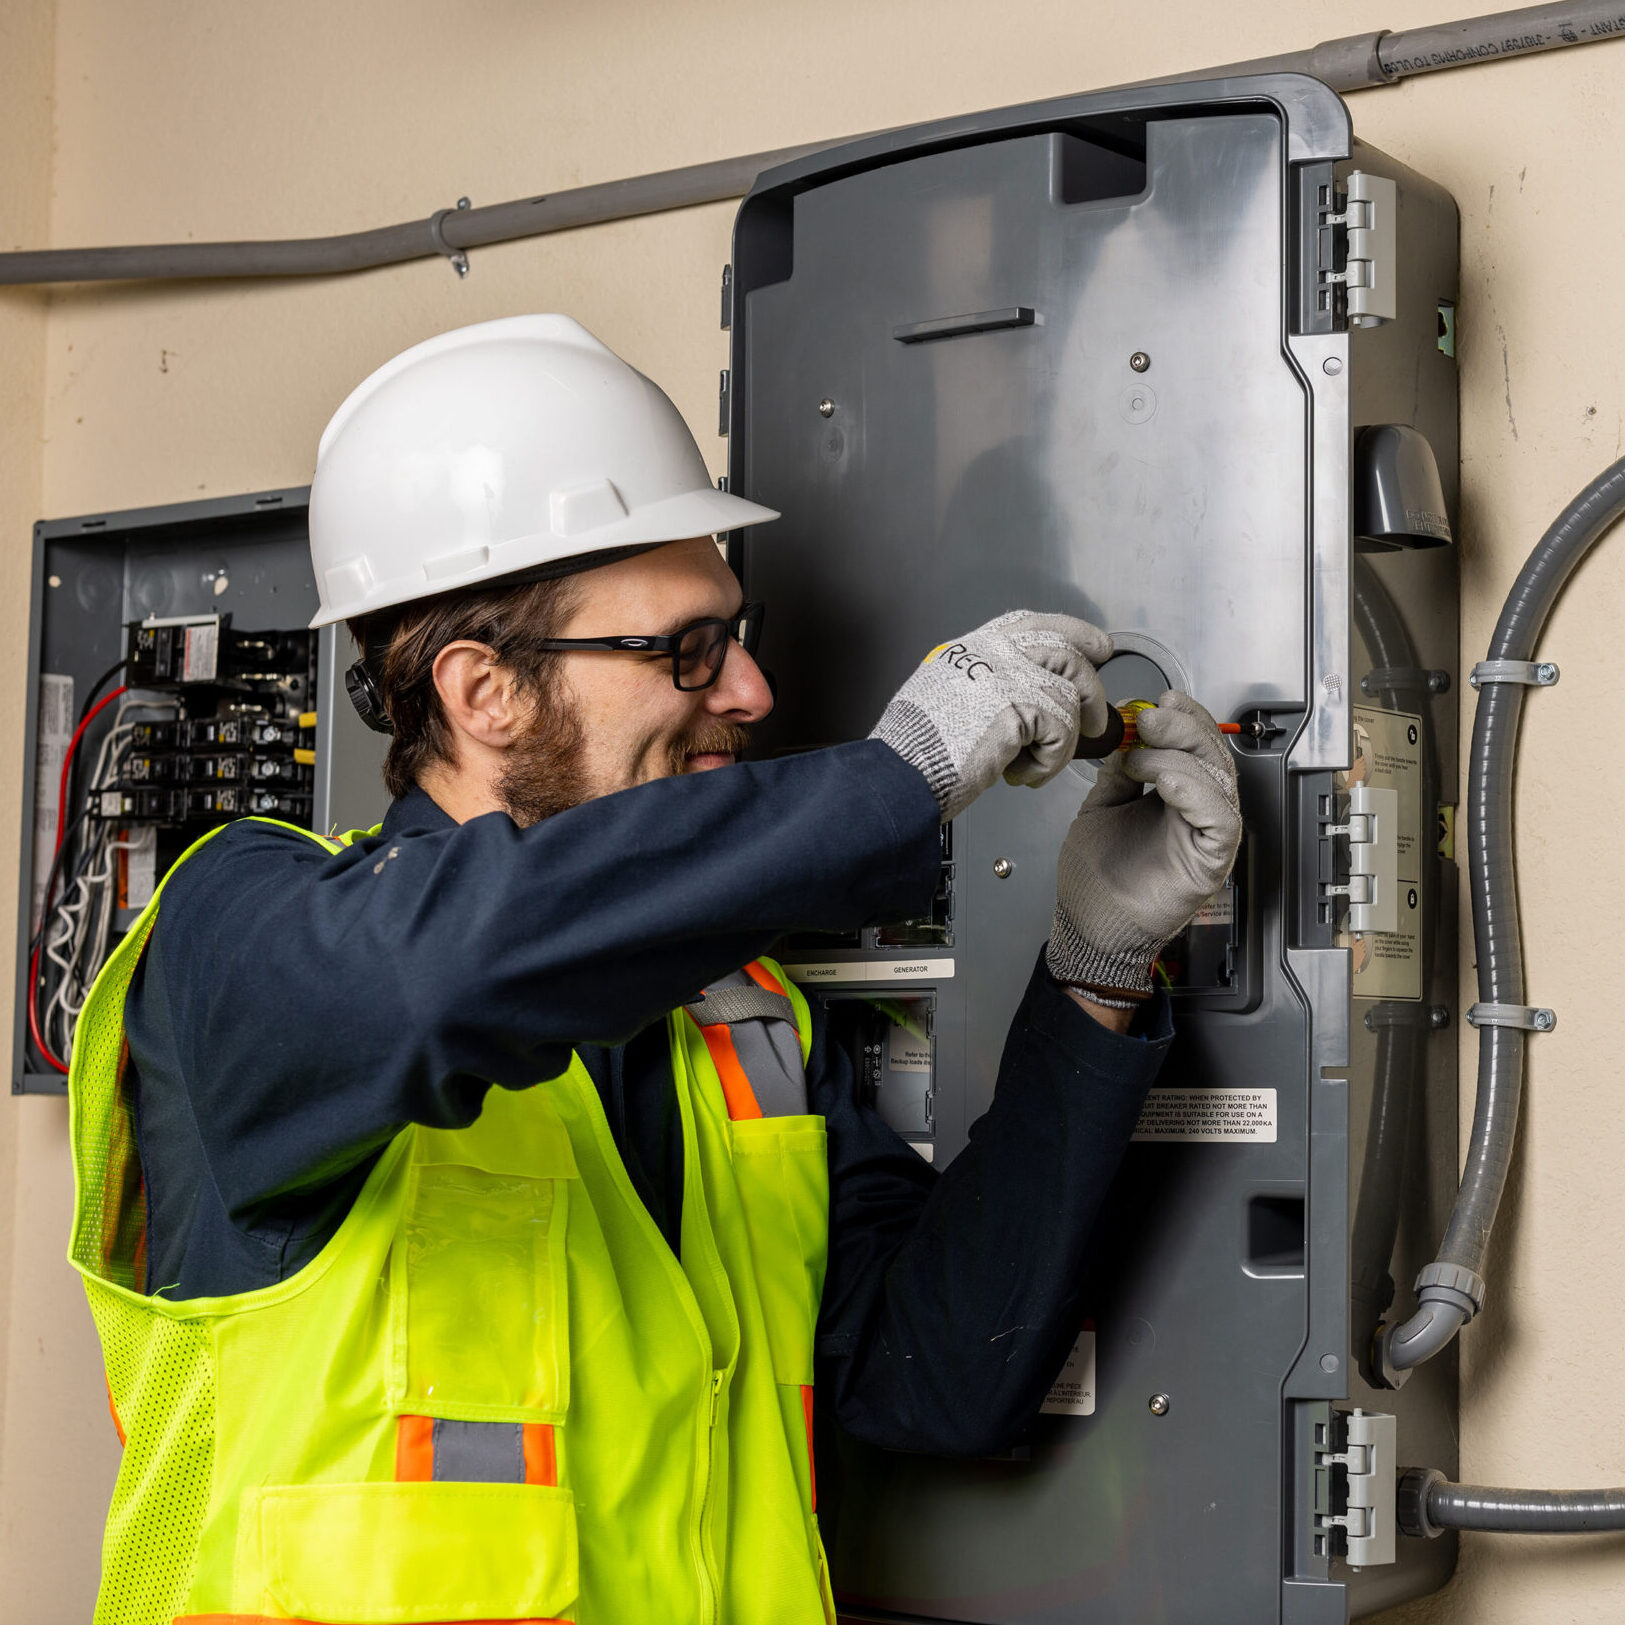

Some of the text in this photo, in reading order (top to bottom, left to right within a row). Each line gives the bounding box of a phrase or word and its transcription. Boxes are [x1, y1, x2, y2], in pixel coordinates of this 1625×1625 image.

[1431, 43, 1498, 65] CONFORMS
[1413, 56, 1431, 68] TO
[939, 644, 994, 681] REC
[806, 969, 838, 977] ENCHARGE
[893, 965, 929, 974] GENERATOR
[1154, 1127, 1187, 1135] MAXIMUM,
